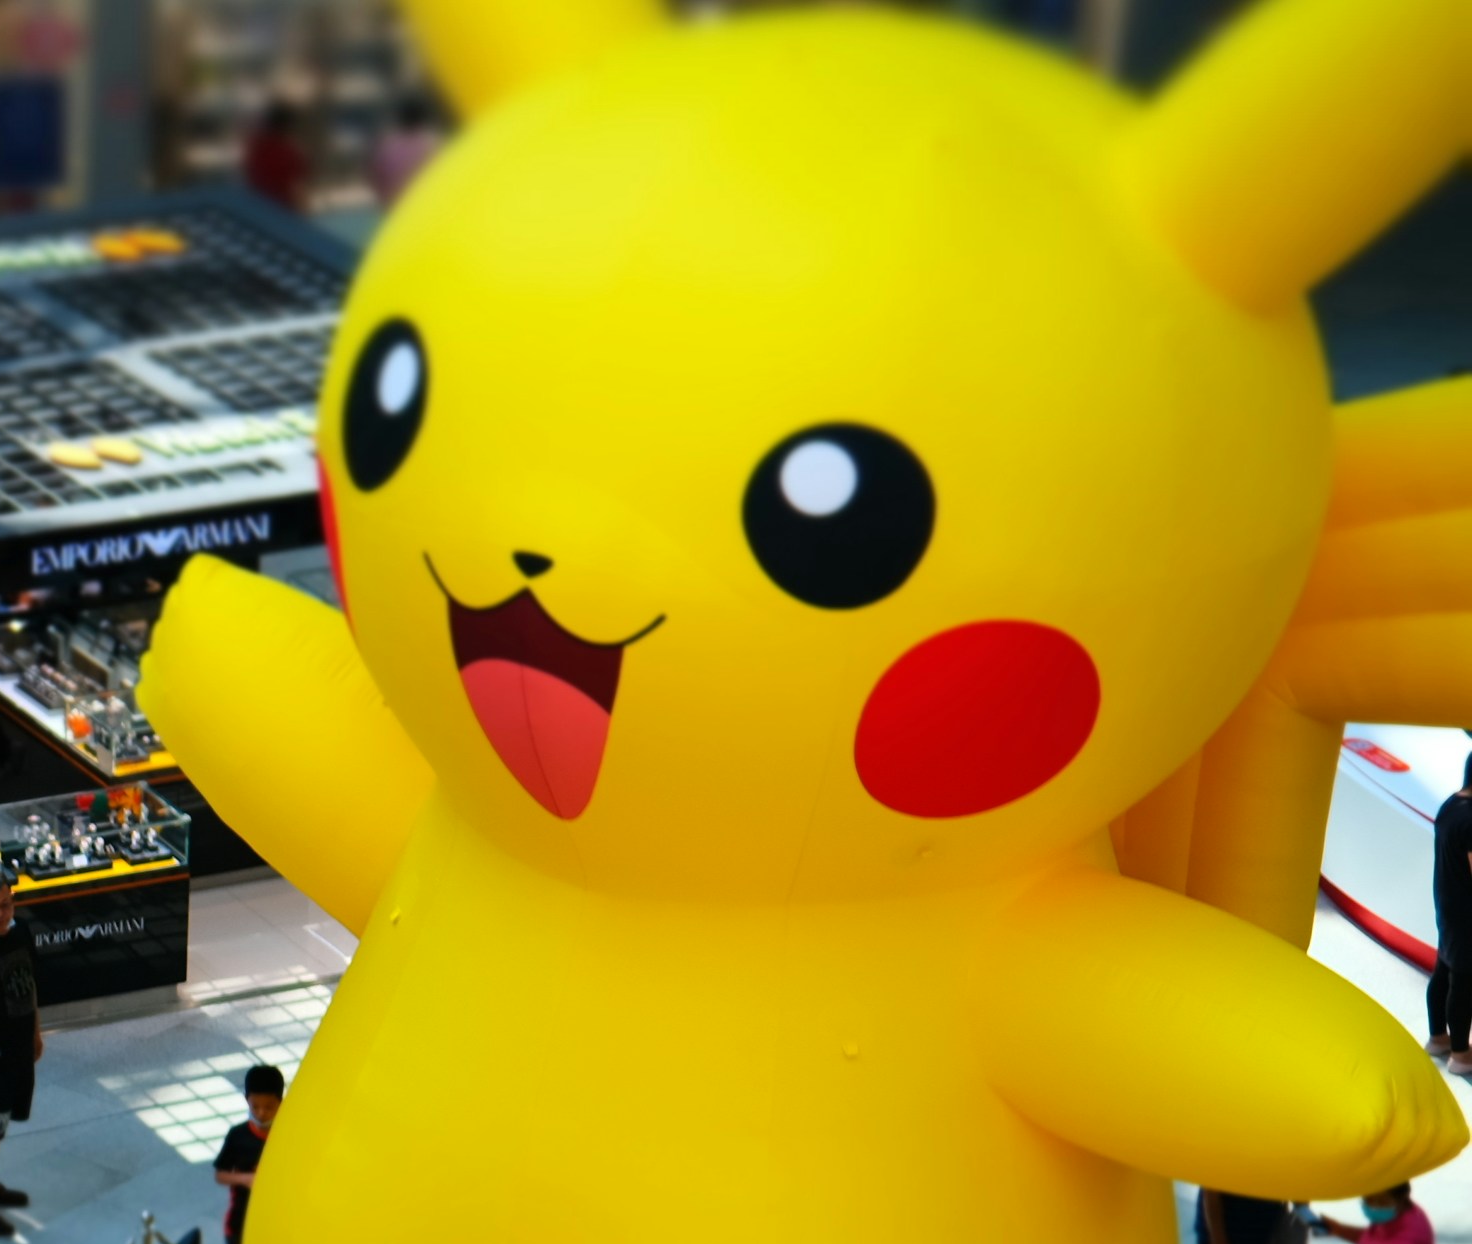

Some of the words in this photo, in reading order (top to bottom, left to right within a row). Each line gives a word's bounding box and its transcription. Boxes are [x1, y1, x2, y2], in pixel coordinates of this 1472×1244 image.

[31, 532, 143, 576] EMPORIO
[175, 512, 271, 552] ARMANI
[35, 927, 79, 947] PORIO
[95, 917, 145, 937] ARMANI
